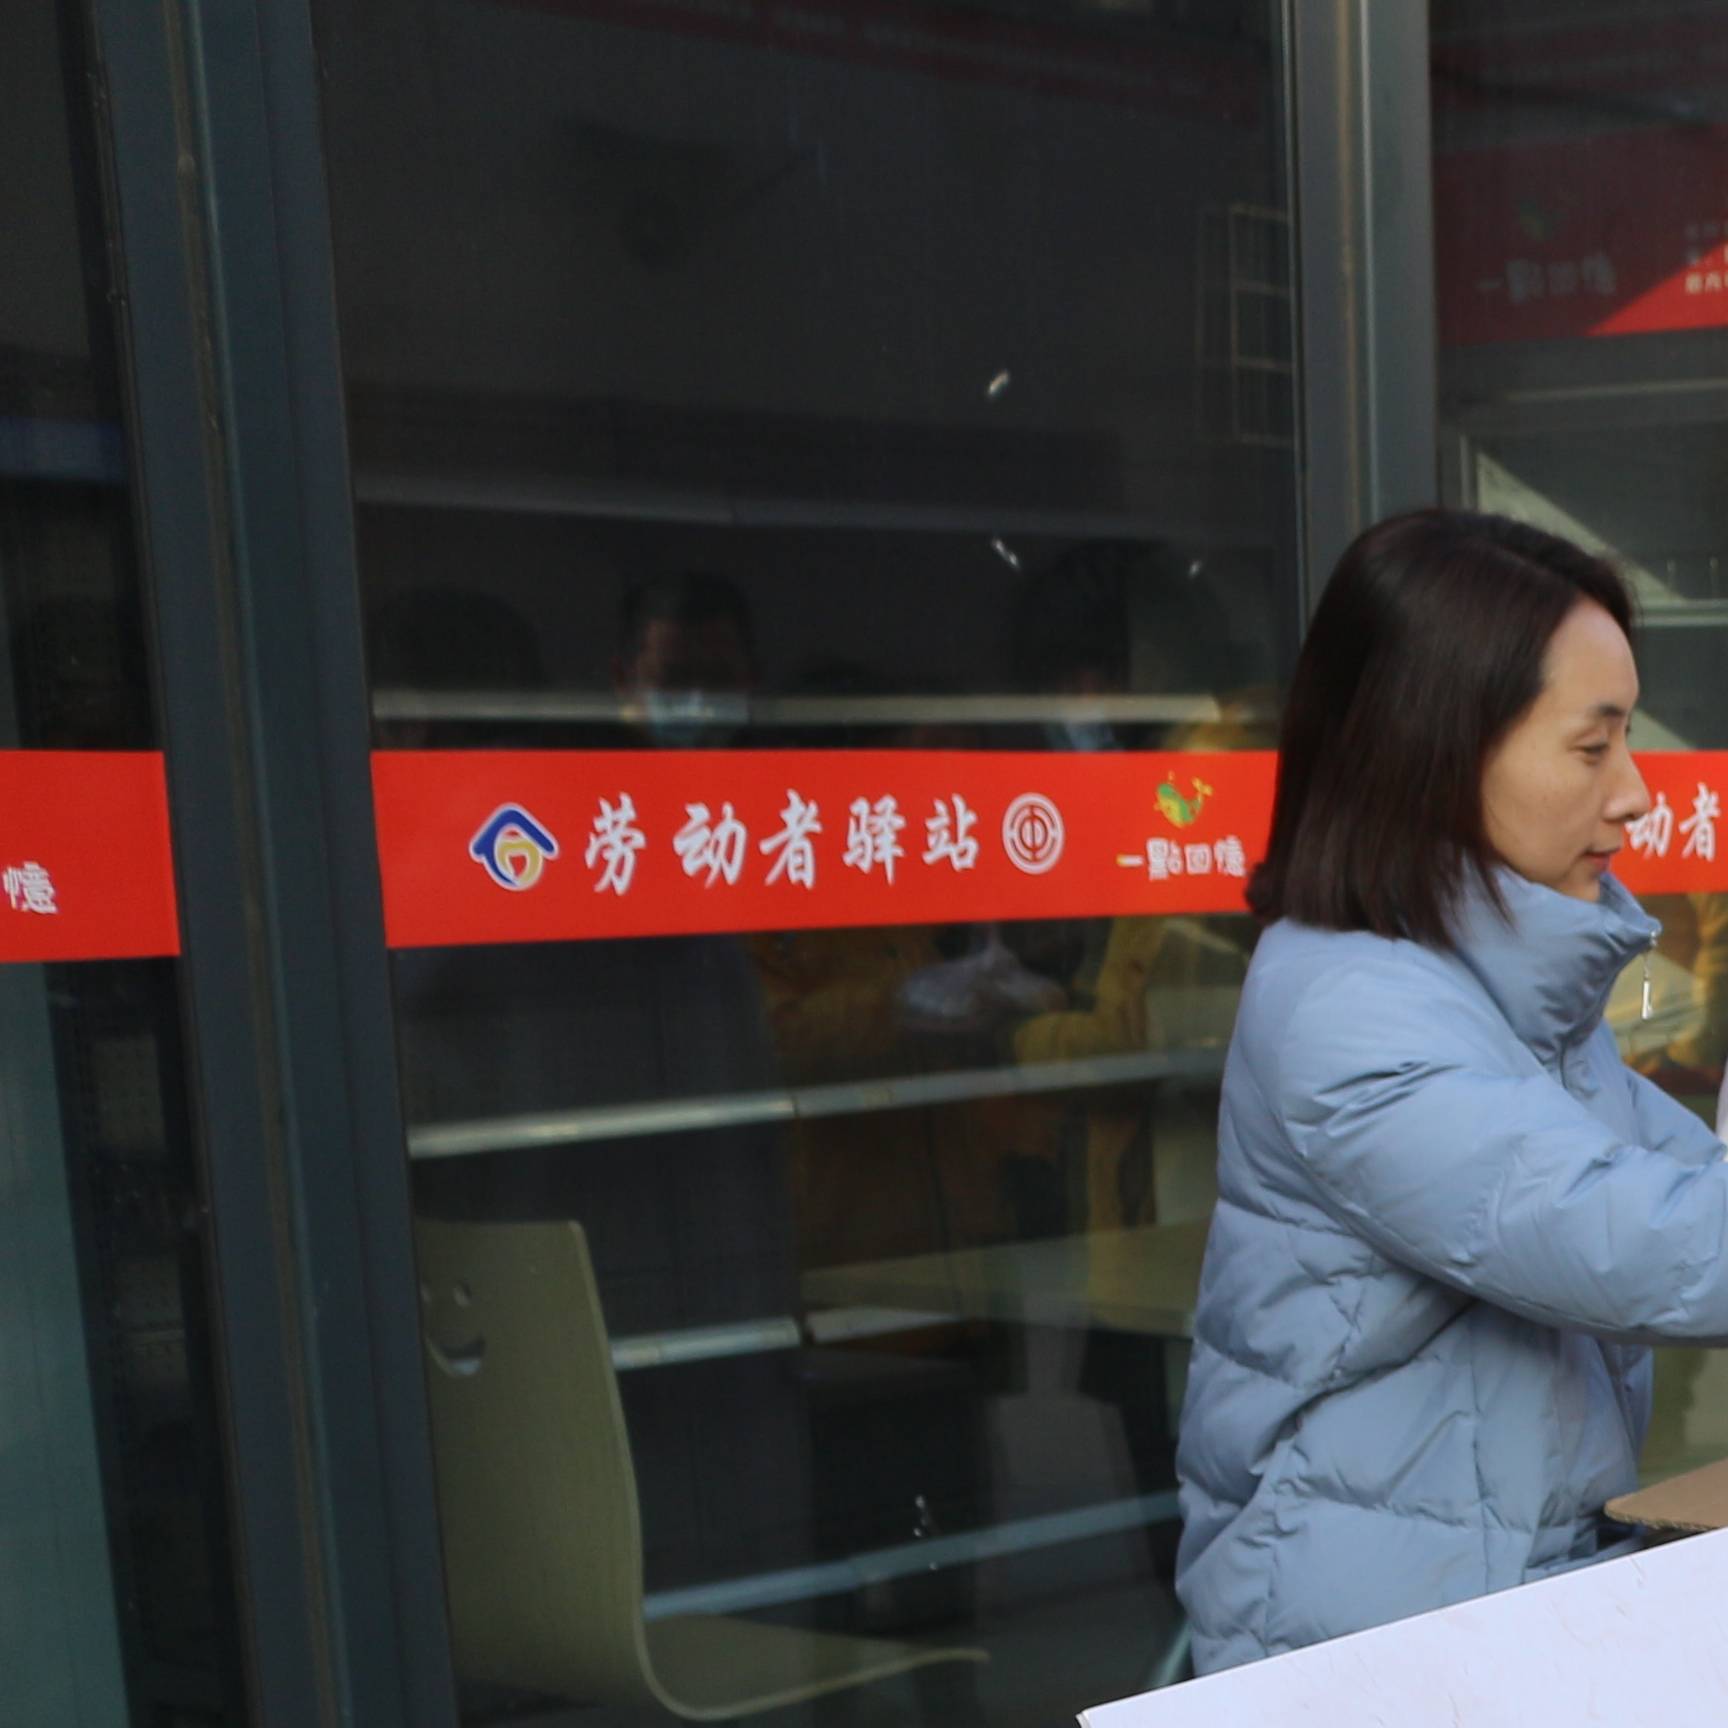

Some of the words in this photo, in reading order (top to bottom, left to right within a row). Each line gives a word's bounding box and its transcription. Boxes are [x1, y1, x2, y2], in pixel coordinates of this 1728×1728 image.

[585, 788, 978, 896] 劳动者驿站
